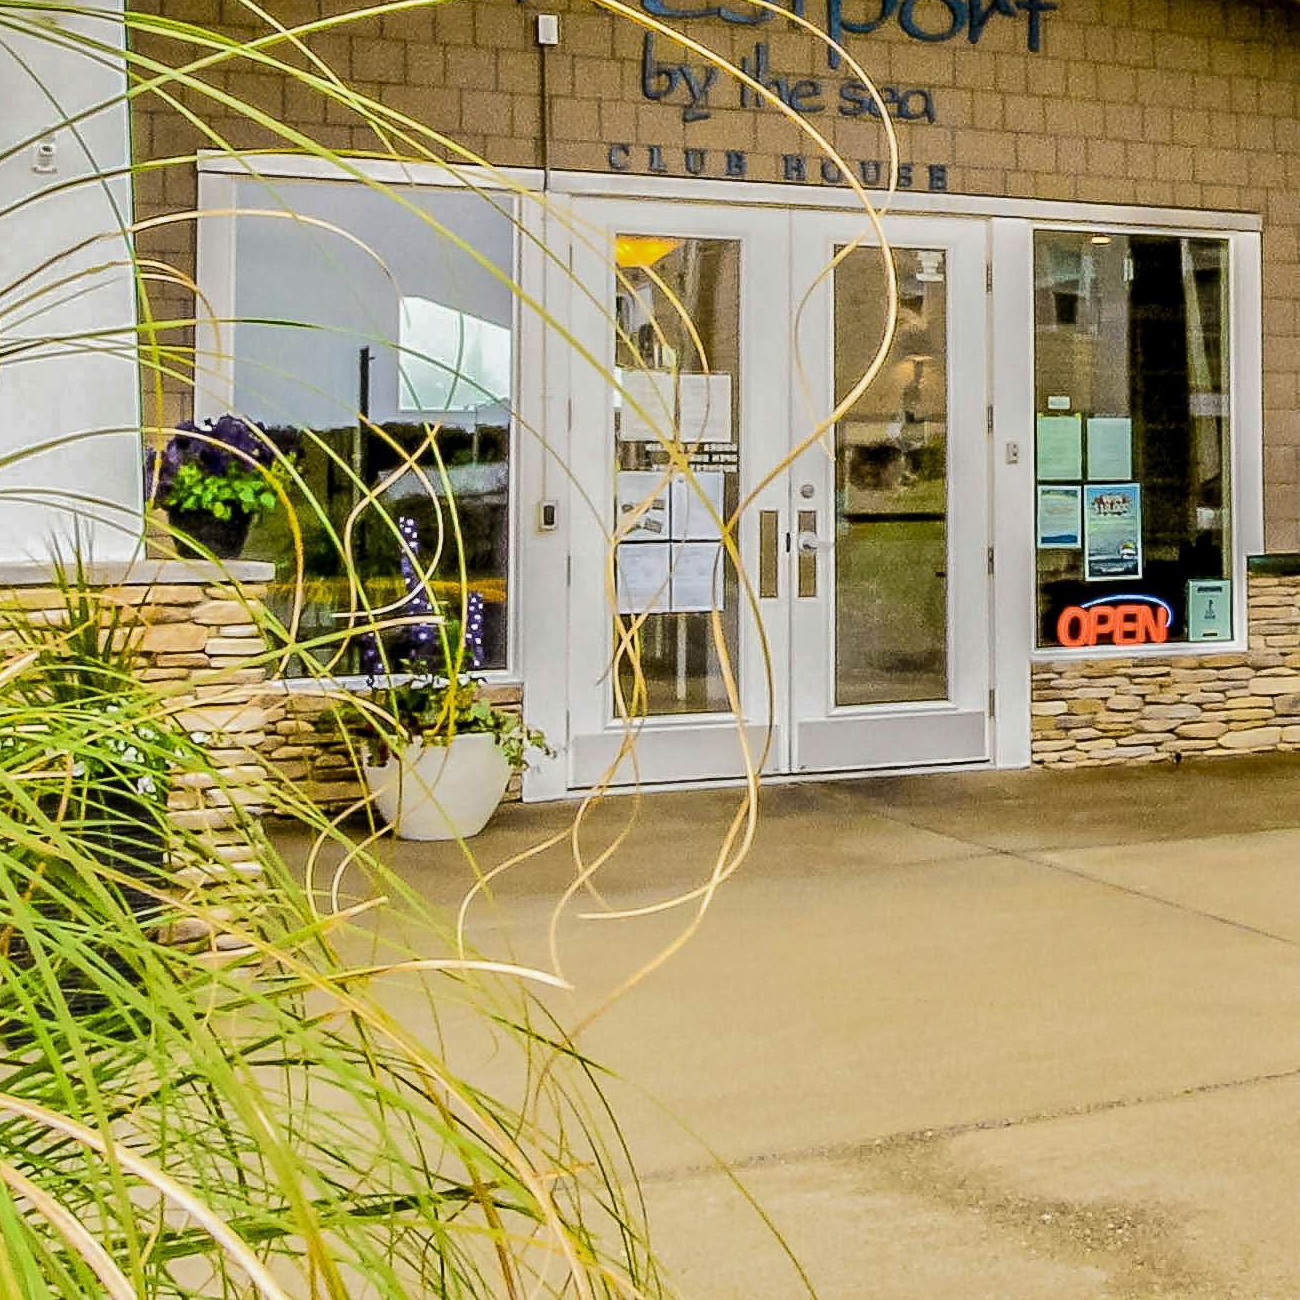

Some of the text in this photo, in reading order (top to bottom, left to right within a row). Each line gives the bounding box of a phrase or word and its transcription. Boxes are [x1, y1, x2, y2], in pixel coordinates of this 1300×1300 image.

[642, 31, 936, 123] by the sea
[607, 143, 948, 192] CLUB HOUSE
[1057, 604, 1168, 647] OPEN
